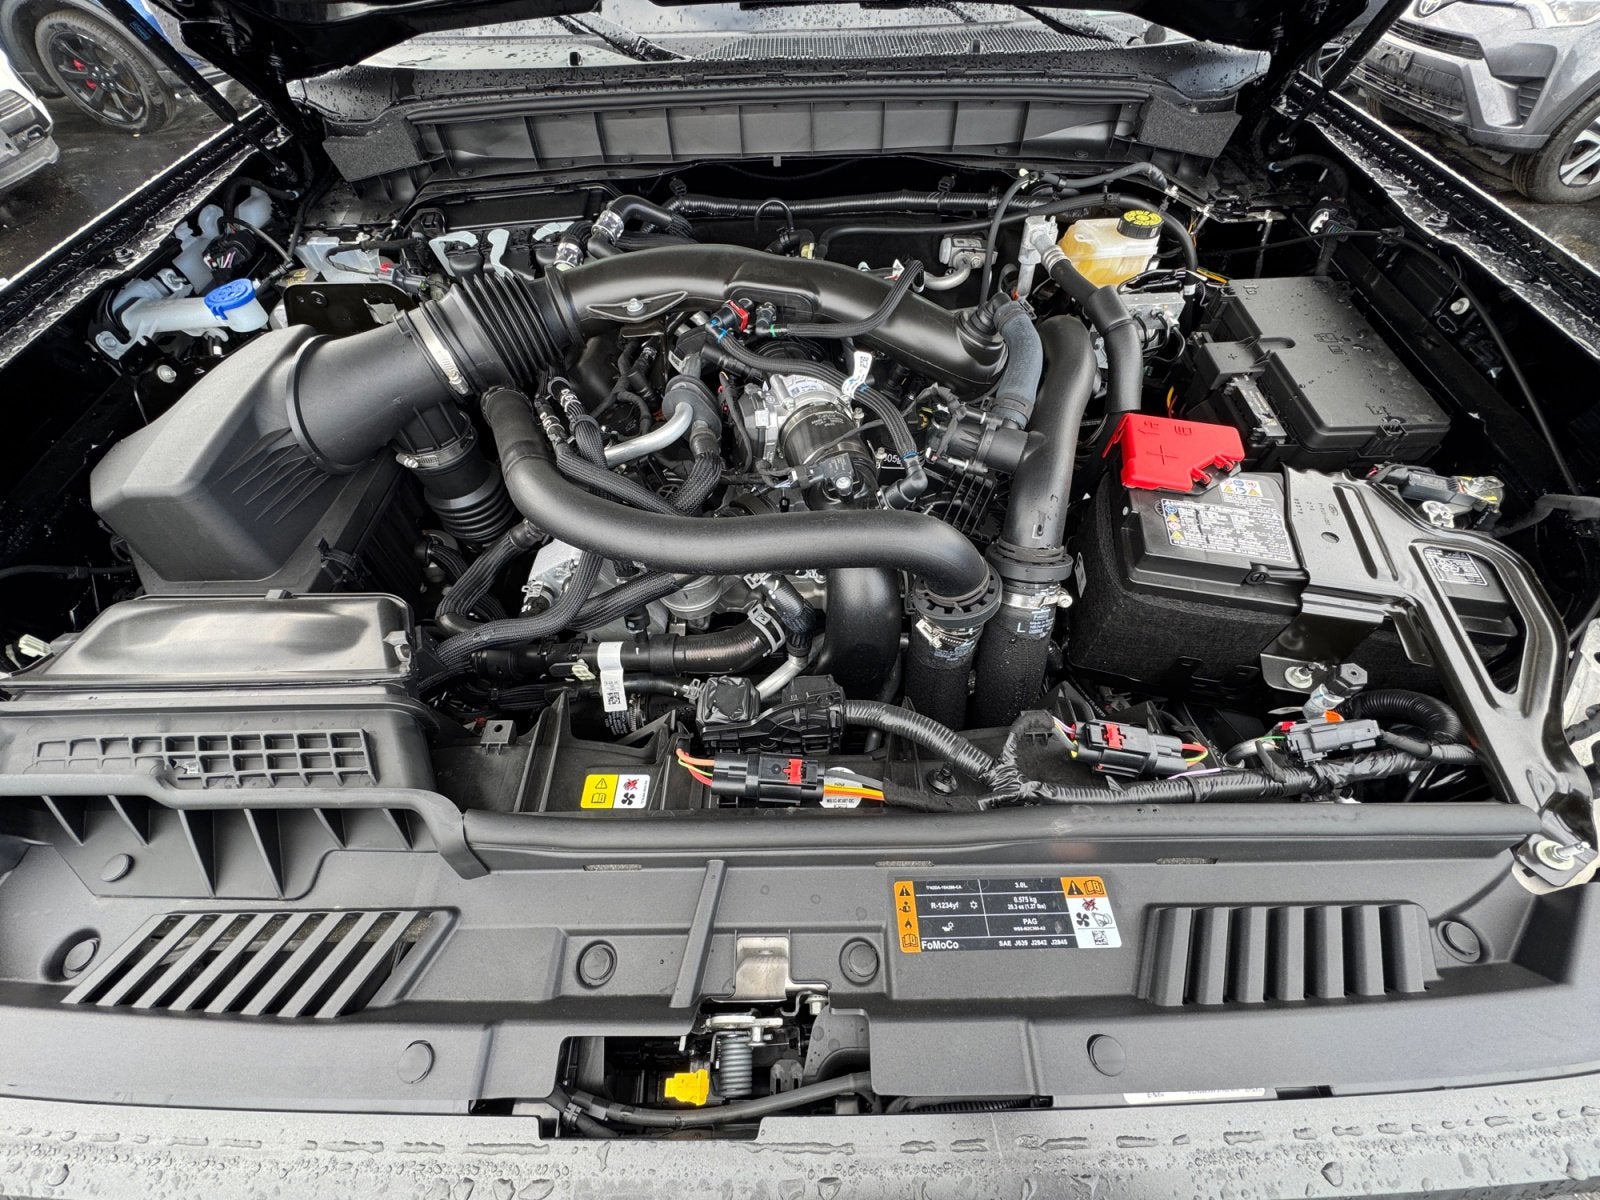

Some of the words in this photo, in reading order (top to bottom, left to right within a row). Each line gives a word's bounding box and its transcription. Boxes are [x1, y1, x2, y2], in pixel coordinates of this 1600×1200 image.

[1016, 622, 1026, 633] L
[1013, 895, 1029, 904] 0.575
[1029, 895, 1038, 905] kg
[930, 901, 959, 910] R-1234yf
[1022, 917, 1038, 925] PAG
[921, 940, 959, 950] FoMoCo
